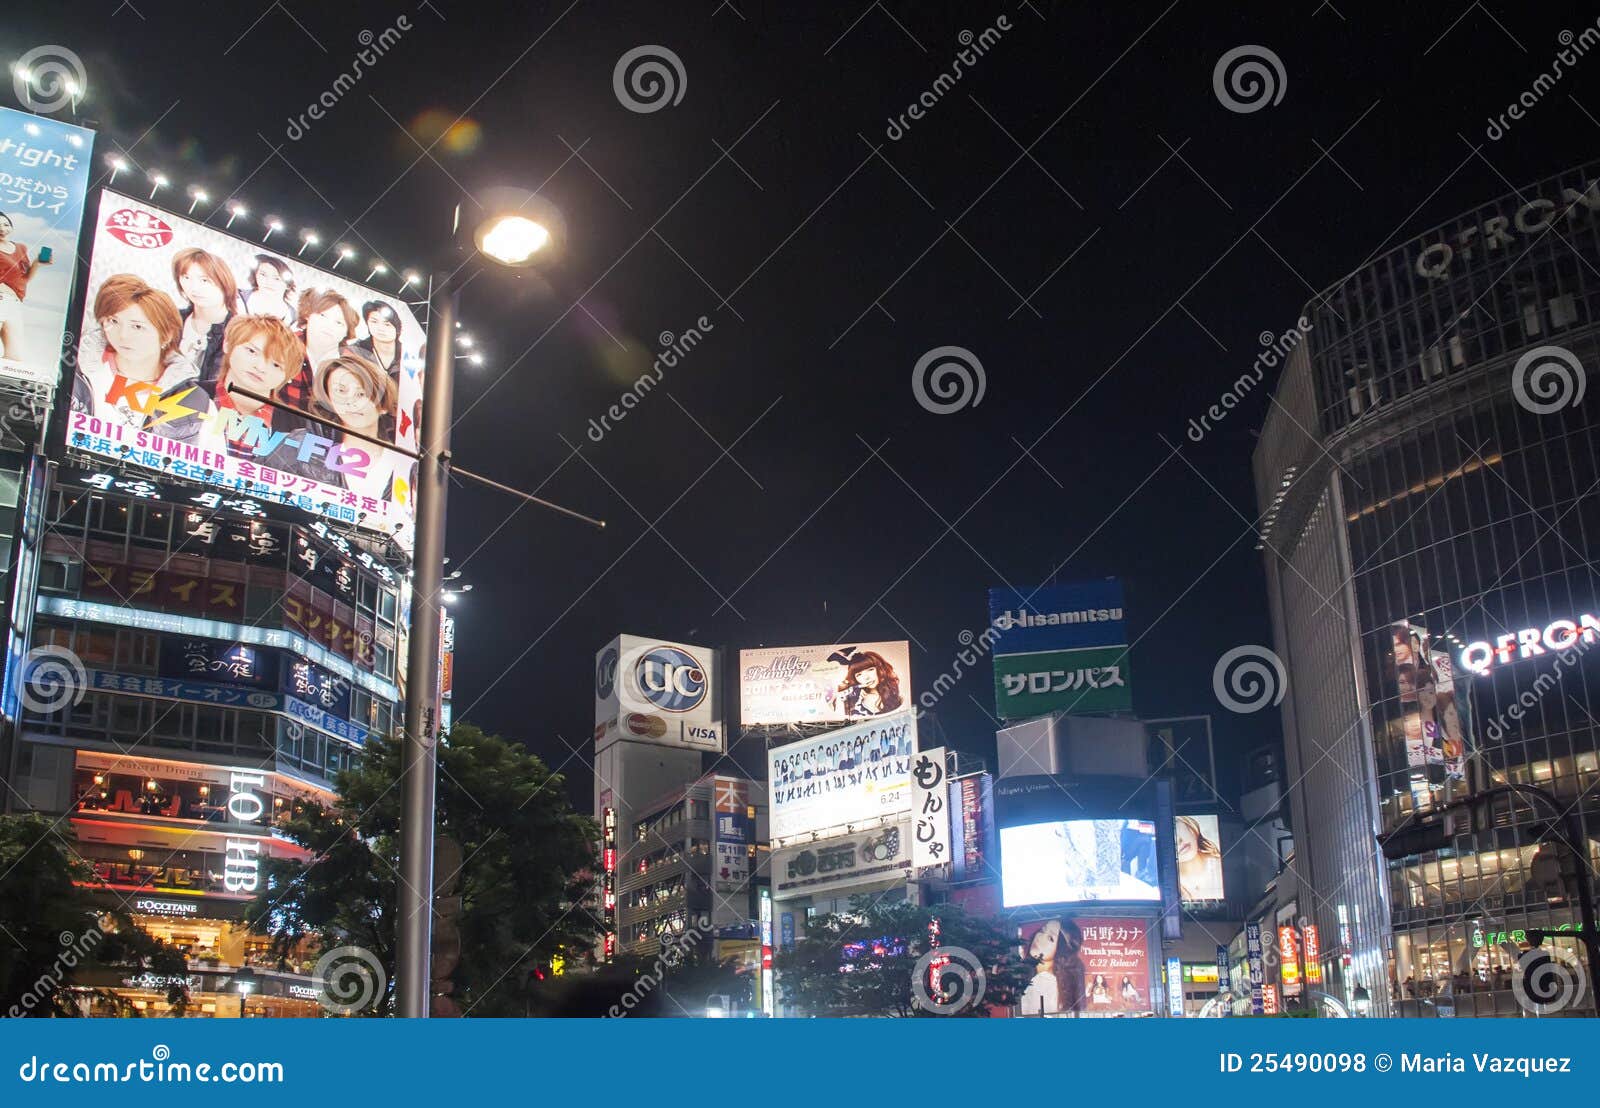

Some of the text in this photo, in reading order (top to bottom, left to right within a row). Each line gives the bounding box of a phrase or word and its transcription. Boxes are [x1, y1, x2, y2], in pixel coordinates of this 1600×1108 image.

[125, 232, 164, 248] GO!
[74, 414, 123, 441] 2011
[136, 431, 227, 470] SUMMER
[998, 607, 1123, 628] Hisamitsu
[1001, 666, 1125, 696] サロンパス
[688, 727, 717, 740] VISA
[715, 781, 747, 813] 本
[913, 755, 944, 859] もんじゃ
[137, 901, 197, 913] L'OCCITANE
[1083, 926, 1143, 941] 西野カナ
